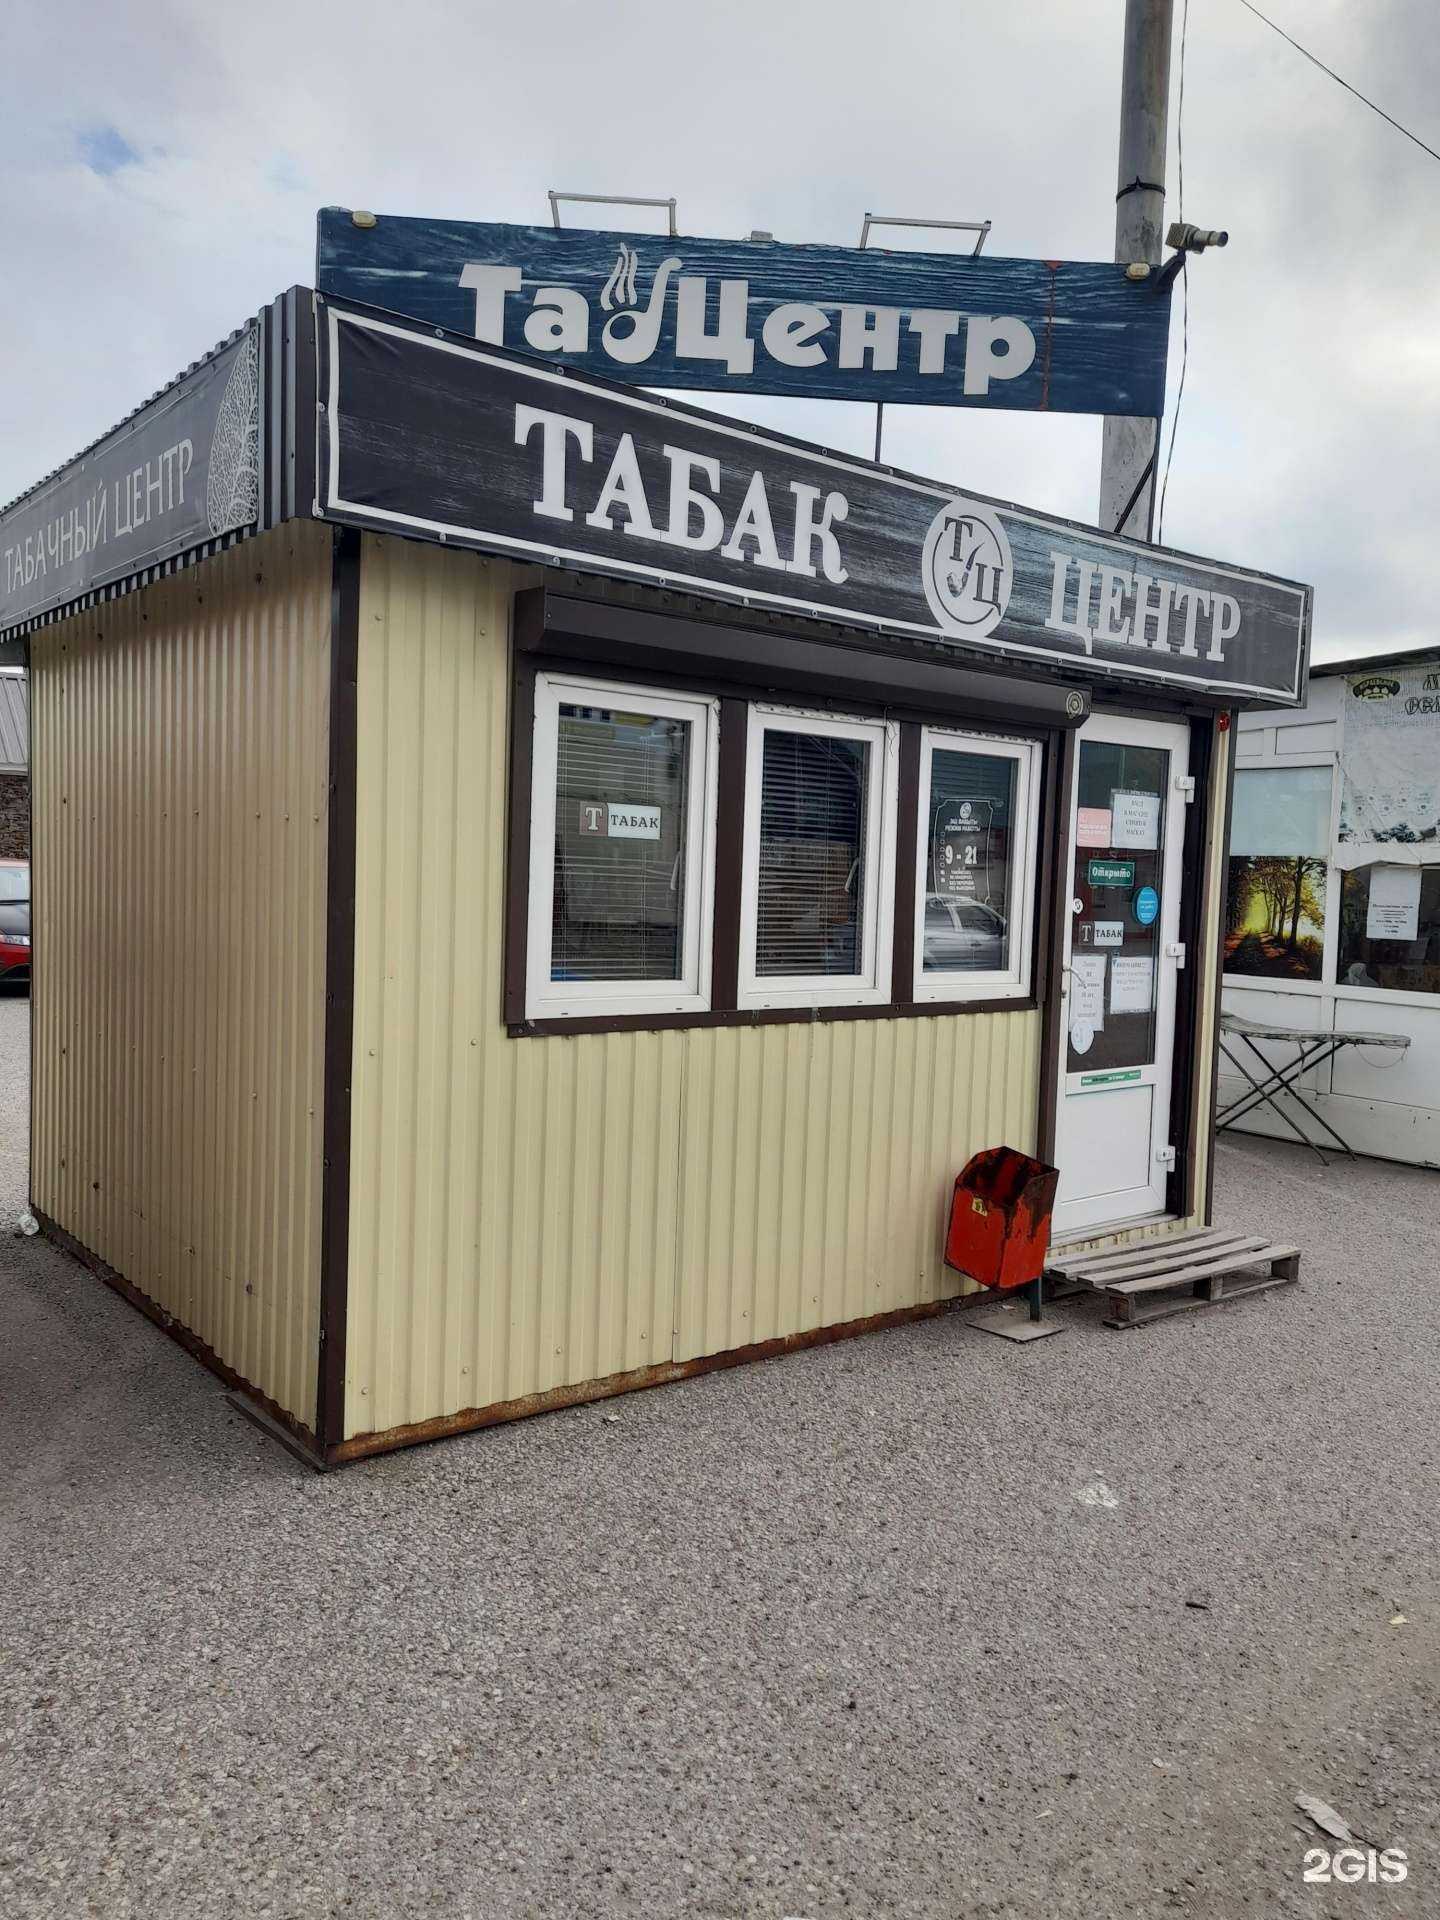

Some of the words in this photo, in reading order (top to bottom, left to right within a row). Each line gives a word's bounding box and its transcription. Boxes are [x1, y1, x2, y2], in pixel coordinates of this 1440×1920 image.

[4, 480, 108, 594] ТАБАЧНЫЙ
[114, 438, 194, 538] ЦЕНТР
[514, 402, 850, 584] ТАБАК
[1044, 550, 1242, 663] ЦЕНТР
[610, 814, 659, 829] ТАБАК
[945, 845, 954, 864] 9
[964, 845, 978, 865] 21
[1091, 866, 1131, 880] Открыто
[1095, 929, 1123, 938] ТАБАК
